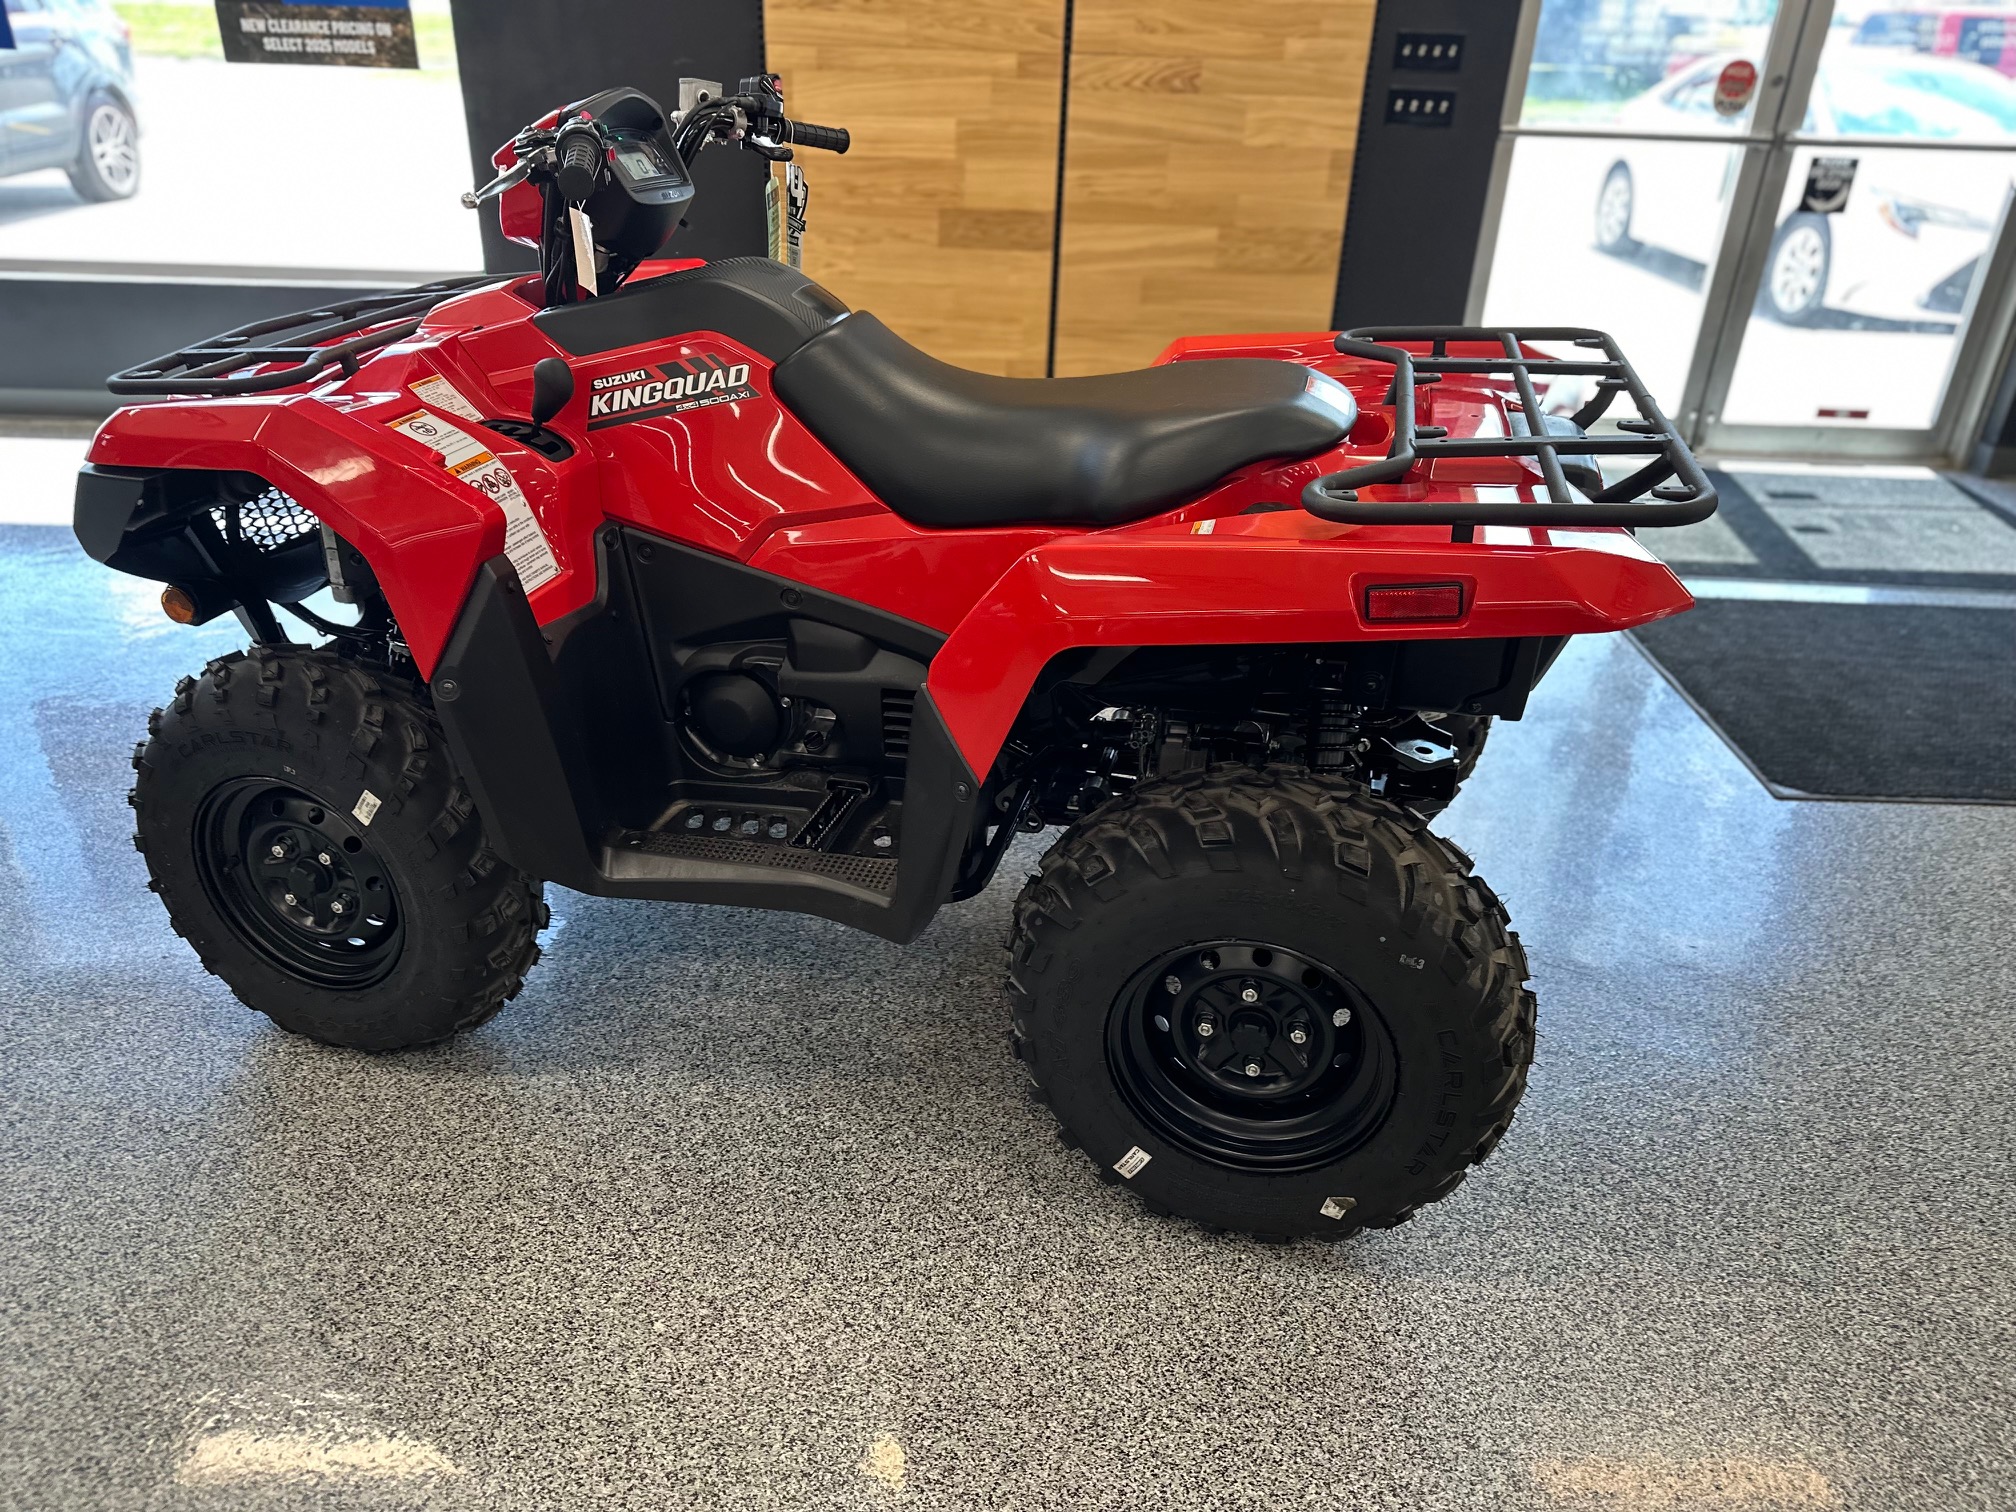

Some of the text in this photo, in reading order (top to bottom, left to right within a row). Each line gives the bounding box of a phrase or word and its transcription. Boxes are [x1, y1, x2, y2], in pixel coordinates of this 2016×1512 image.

[239, 17, 393, 38] NEW CLEARANCE PRICING ON
[262, 36, 377, 55] SELECT 2025 MODELS
[590, 363, 750, 417] KINGQUAD
[593, 369, 647, 390] SUZUKI
[699, 391, 750, 407] 500AXi
[177, 729, 291, 758] CARLSTAR
[1404, 1028, 1464, 1177] CARLSTAR
